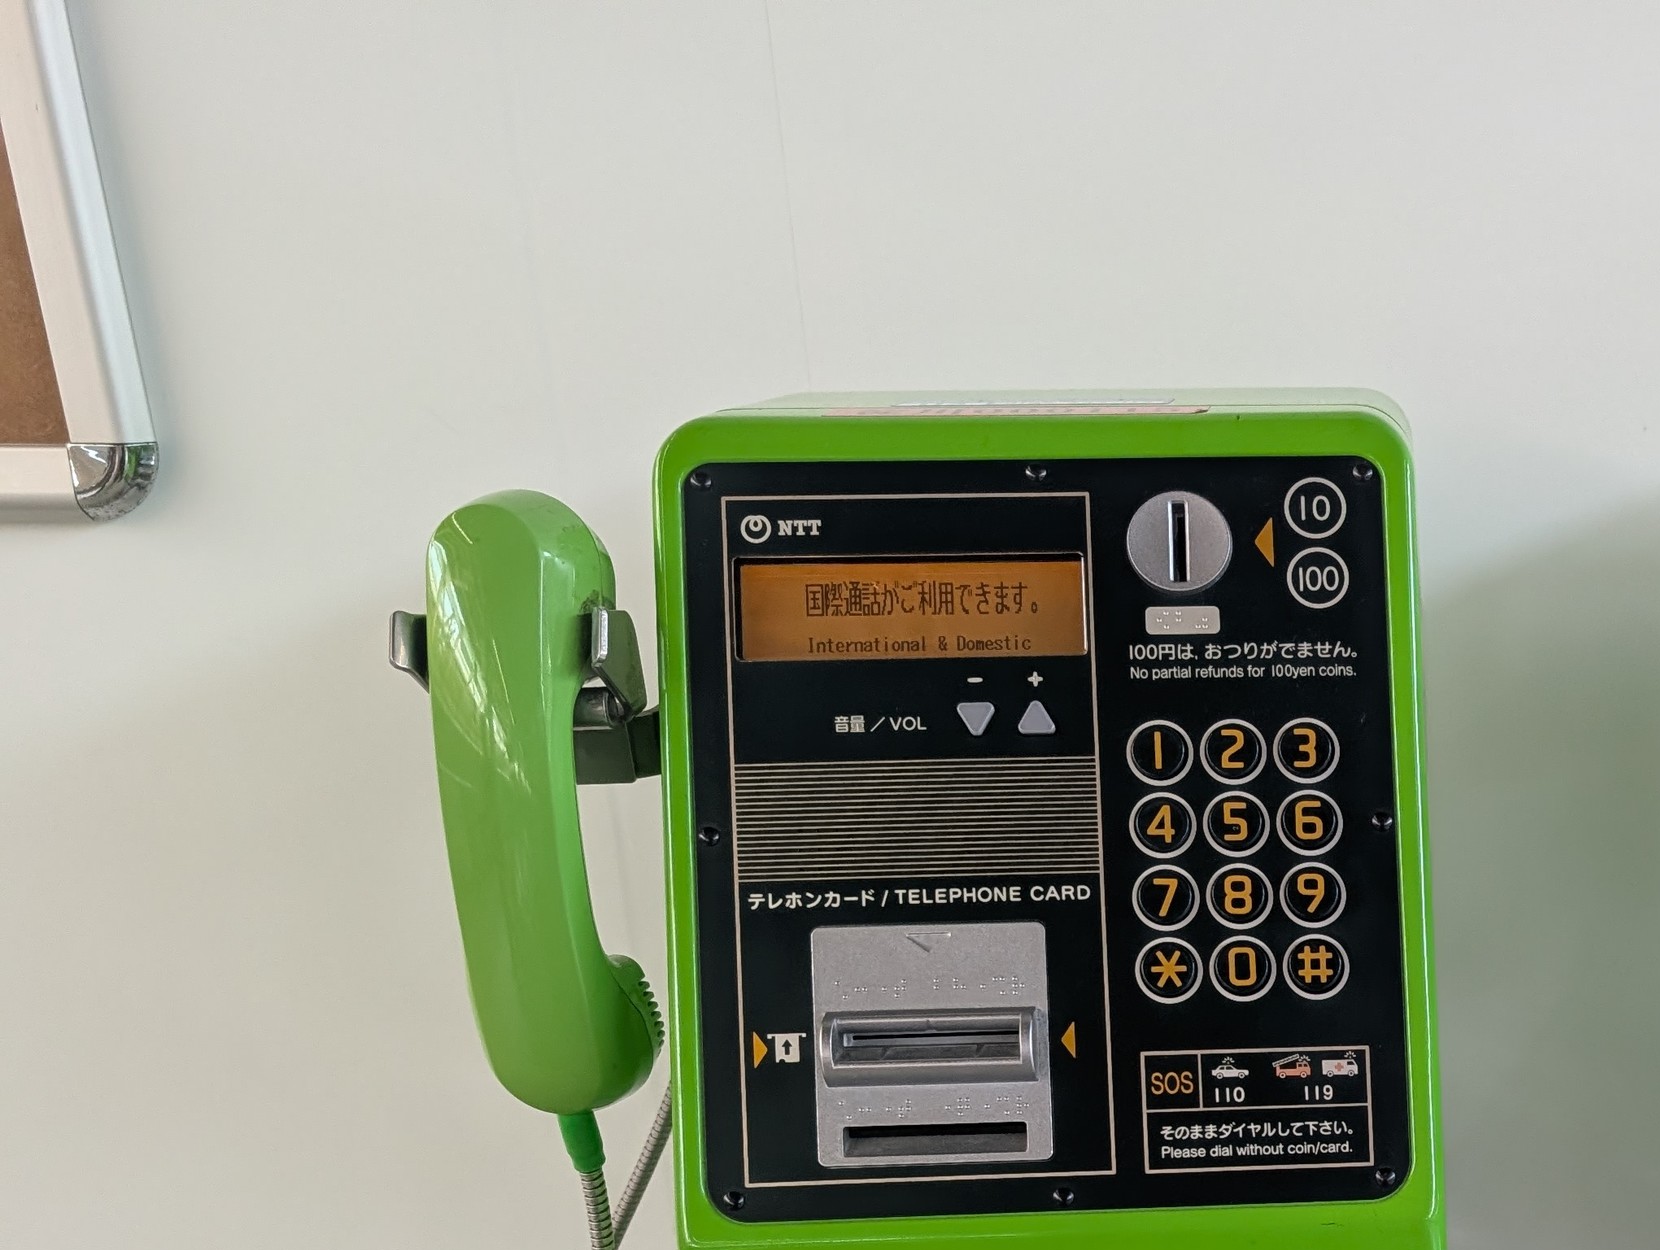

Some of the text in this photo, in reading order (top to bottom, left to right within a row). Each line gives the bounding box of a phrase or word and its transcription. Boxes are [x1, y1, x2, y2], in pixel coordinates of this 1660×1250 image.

[1300, 495, 1331, 521] 10
[777, 519, 822, 536] NTT
[1298, 566, 1339, 592] 100
[805, 580, 1039, 617] 国際通話がご利用できます。
[808, 634, 1032, 653] International & Domestic
[1130, 663, 1357, 681] No partial refunds for 100yen coins.
[834, 715, 865, 733] 音量
[889, 716, 927, 731] VOL
[1154, 732, 1162, 769] 1
[1221, 730, 1244, 768] 2
[1294, 729, 1316, 767] 3
[1147, 805, 1174, 842] 4
[1224, 802, 1247, 840] 5
[1295, 801, 1323, 839] 6
[748, 889, 875, 910] テレホンカード
[895, 887, 1021, 904] TELEPHONE
[1030, 885, 1091, 901] CARD
[1153, 879, 1177, 916] 7
[1225, 875, 1252, 914] 8
[1298, 874, 1324, 912] 9
[1228, 947, 1256, 986] 0
[1151, 1071, 1194, 1095] SOS
[1215, 1087, 1245, 1103] 110
[1304, 1085, 1334, 1101] 119
[1160, 1121, 1353, 1140] そのままダイヤルして下さい。
[1161, 1141, 1353, 1159] Please dial without coin/card.
